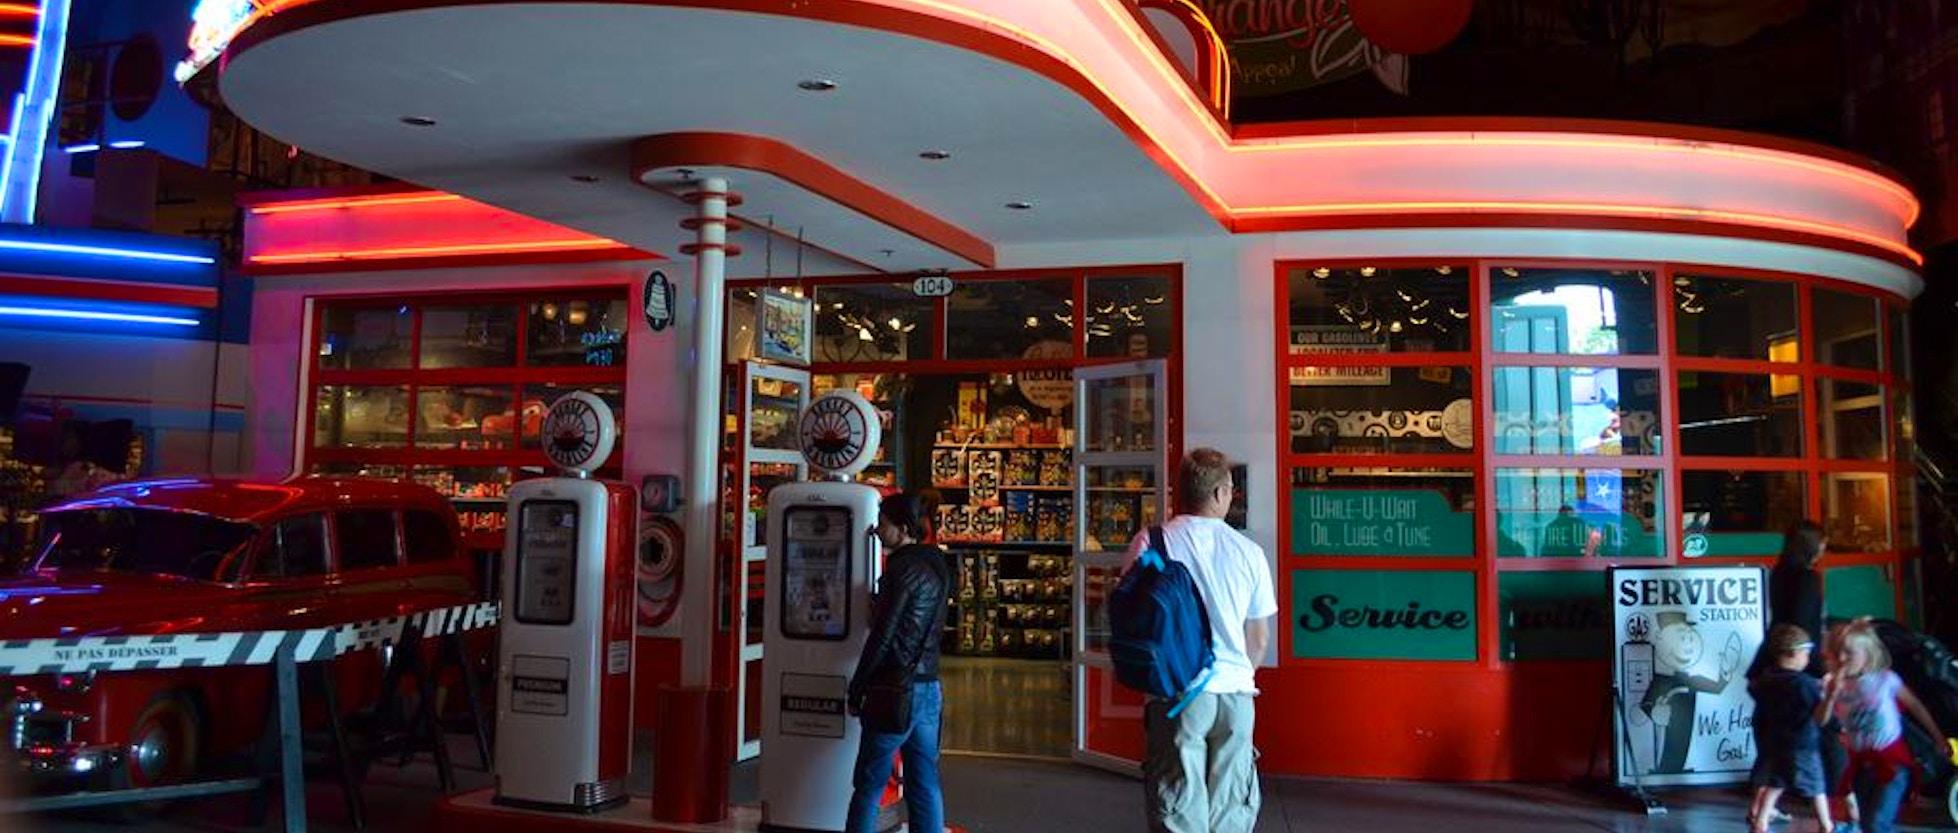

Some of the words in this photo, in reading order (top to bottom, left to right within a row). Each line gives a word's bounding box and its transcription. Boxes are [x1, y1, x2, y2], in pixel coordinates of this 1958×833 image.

[921, 279, 945, 294] 104
[1619, 578, 1757, 606] SERVICE
[1300, 594, 1468, 632] Service
[1699, 608, 1758, 622] STATION
[1626, 616, 1649, 636] GAS
[55, 650, 72, 662] NE
[78, 648, 105, 660] PAS
[1698, 711, 1720, 736] We
